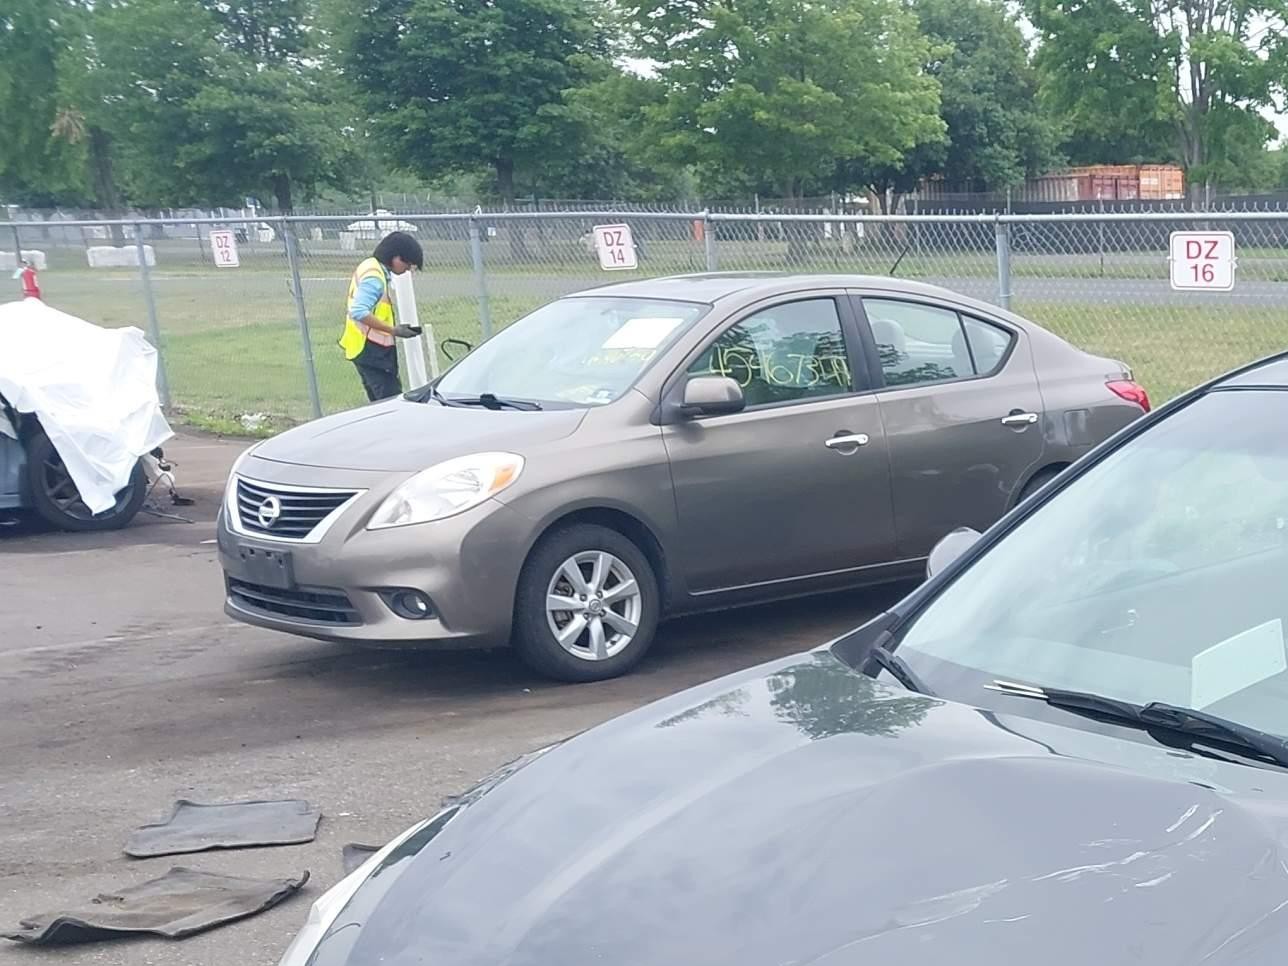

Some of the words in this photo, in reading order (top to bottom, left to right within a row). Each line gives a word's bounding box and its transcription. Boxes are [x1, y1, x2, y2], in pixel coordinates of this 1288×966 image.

[216, 235, 231, 249] DZ
[603, 231, 625, 247] DZ
[220, 249, 231, 262] 12
[609, 248, 625, 264] 14
[1186, 240, 1219, 260] DZ
[1190, 263, 1215, 283] 16
